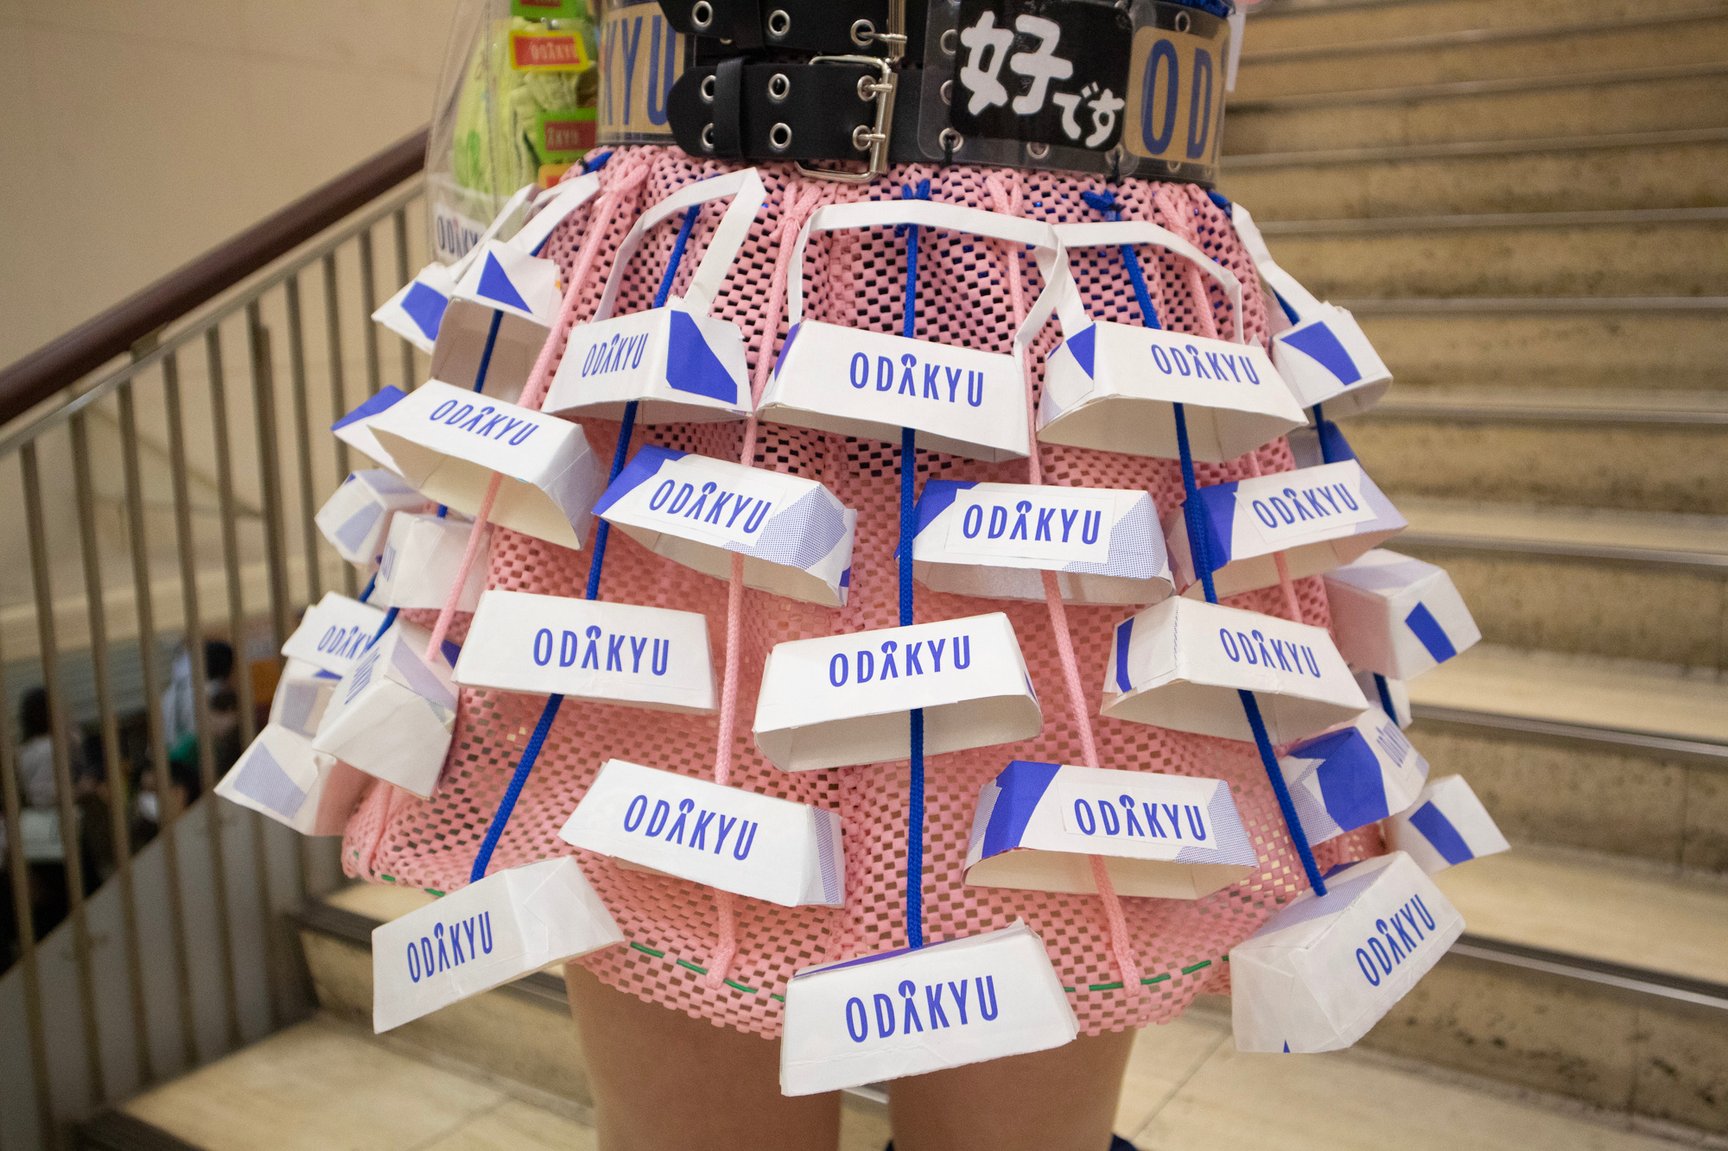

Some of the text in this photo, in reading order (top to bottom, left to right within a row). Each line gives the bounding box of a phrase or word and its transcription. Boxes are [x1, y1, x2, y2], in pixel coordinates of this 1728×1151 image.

[1141, 38, 1229, 163] OD
[582, 332, 649, 378] ODAKYU
[849, 351, 985, 408] ODAKYU
[1151, 343, 1261, 386] ODAKYU
[429, 399, 539, 447] ODAKYU
[648, 479, 773, 535] ODAKYU
[962, 500, 1102, 546] ODAKYU
[1252, 482, 1359, 530] ODAKYU
[533, 624, 670, 677] ODAKYU
[829, 634, 972, 688] ODAKYU
[1219, 628, 1321, 678] ODAKYU
[623, 794, 759, 862] ODAKYU
[1073, 794, 1207, 843] ODAKYU
[406, 910, 494, 984] ODAKYU
[1354, 893, 1437, 988] ODAKYU
[845, 974, 1000, 1044] ODAKYU
